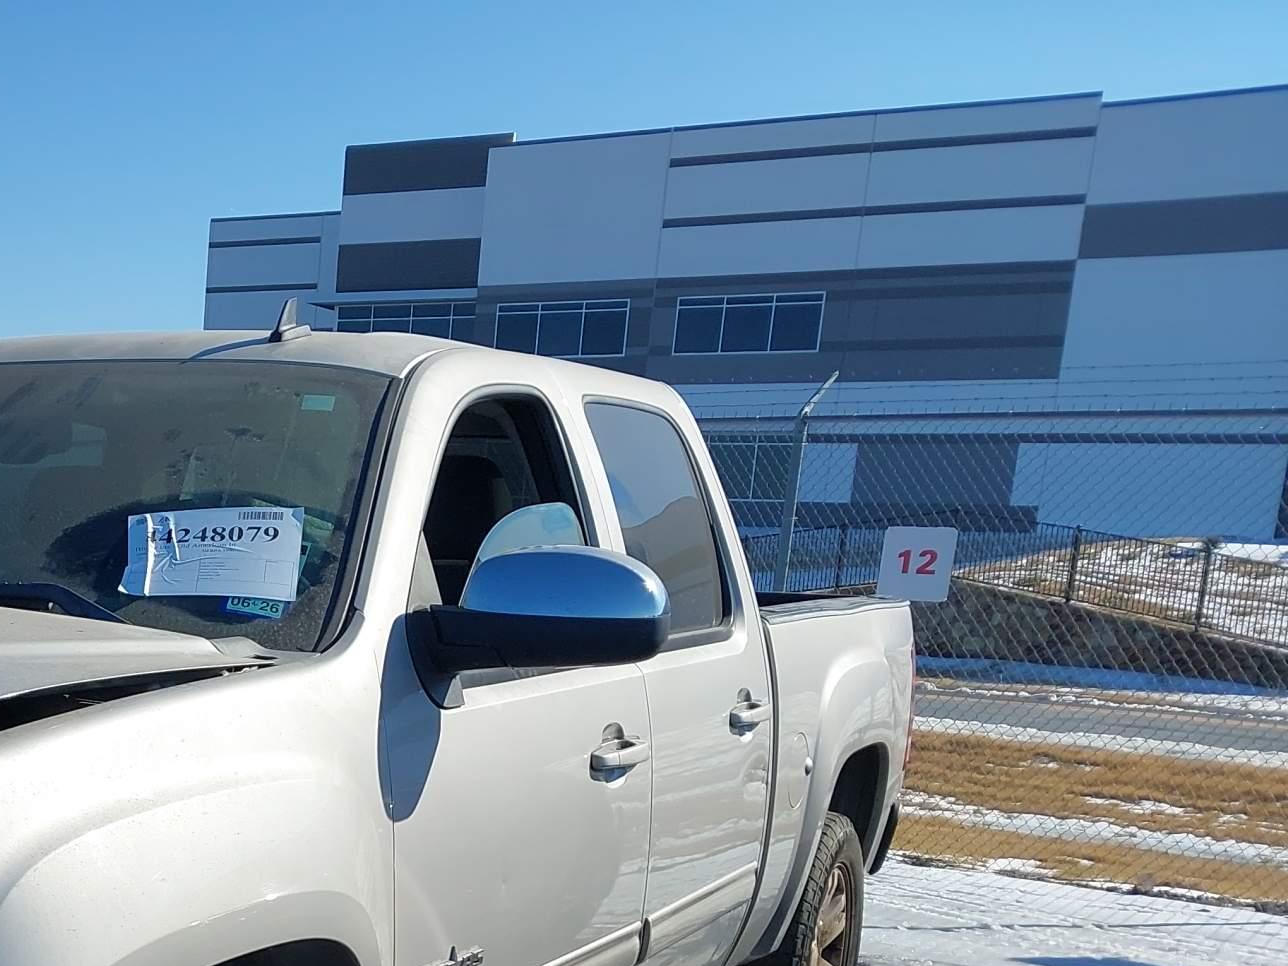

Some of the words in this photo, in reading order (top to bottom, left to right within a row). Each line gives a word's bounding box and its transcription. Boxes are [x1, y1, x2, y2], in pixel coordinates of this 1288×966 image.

[897, 549, 938, 575] 12
[231, 597, 251, 608] 06
[259, 601, 280, 614] 26
